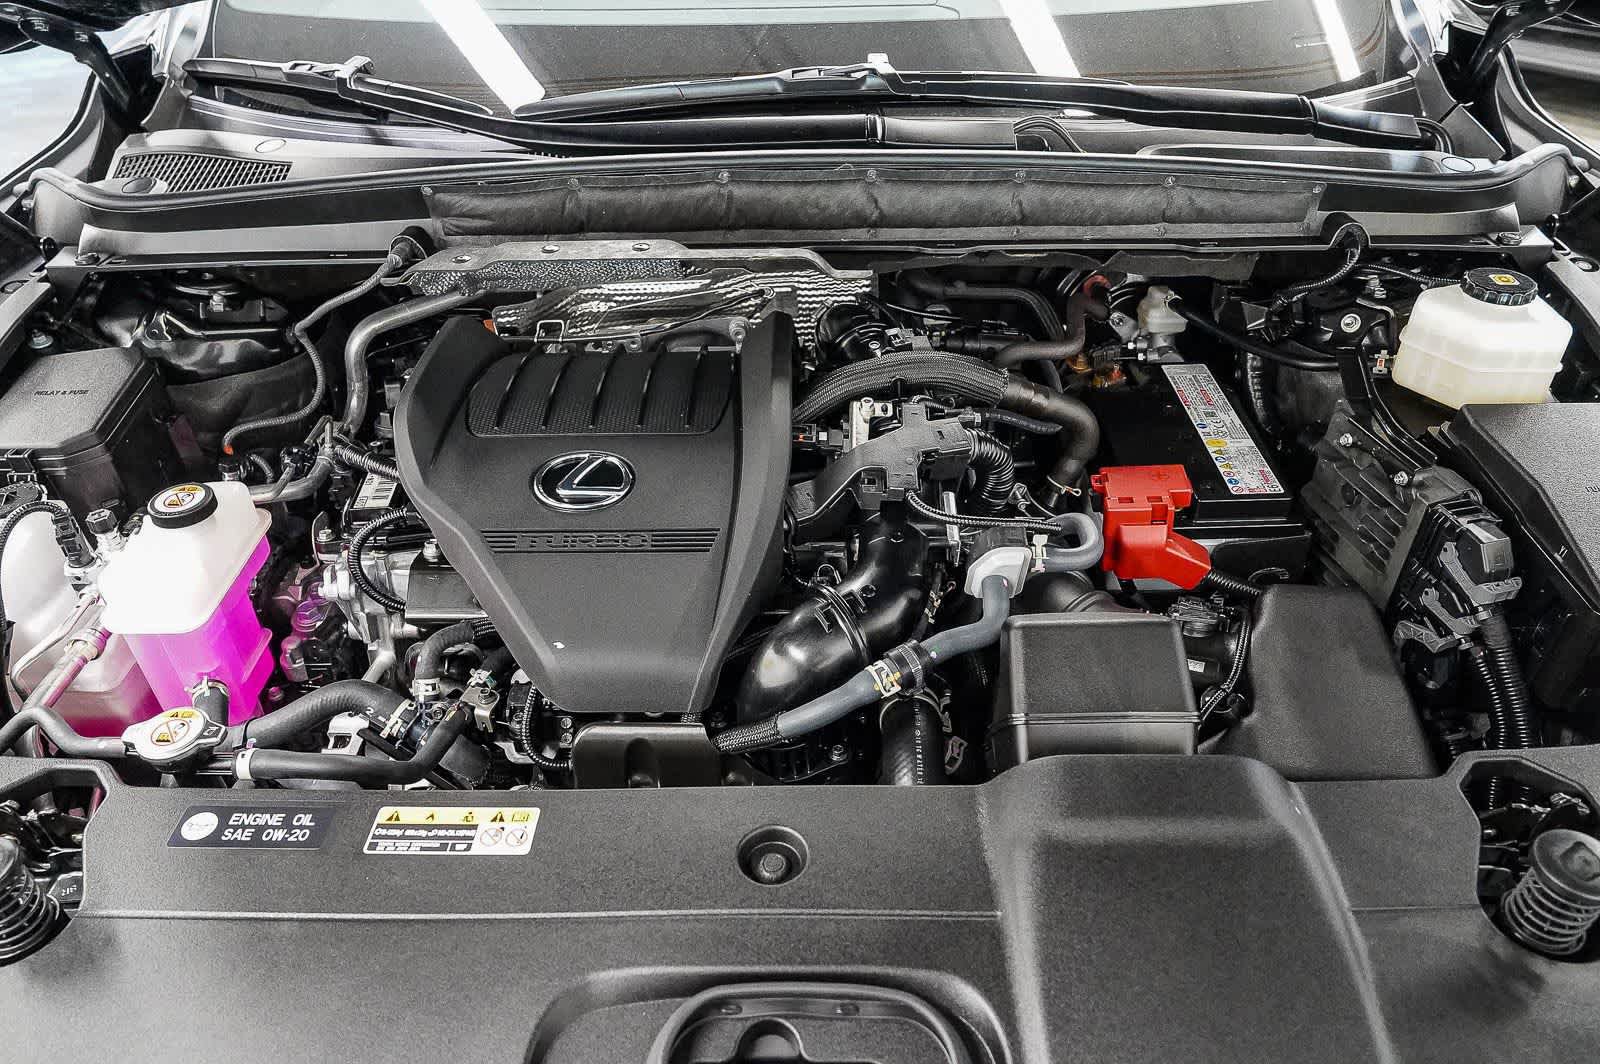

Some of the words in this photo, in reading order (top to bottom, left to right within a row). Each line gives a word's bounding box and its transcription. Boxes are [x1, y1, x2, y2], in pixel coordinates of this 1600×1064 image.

[520, 532, 649, 548] TURBO
[228, 813, 286, 826] ENGINE
[292, 813, 315, 826] OIL
[221, 828, 255, 841] SAE
[262, 828, 310, 841] 0W-20
